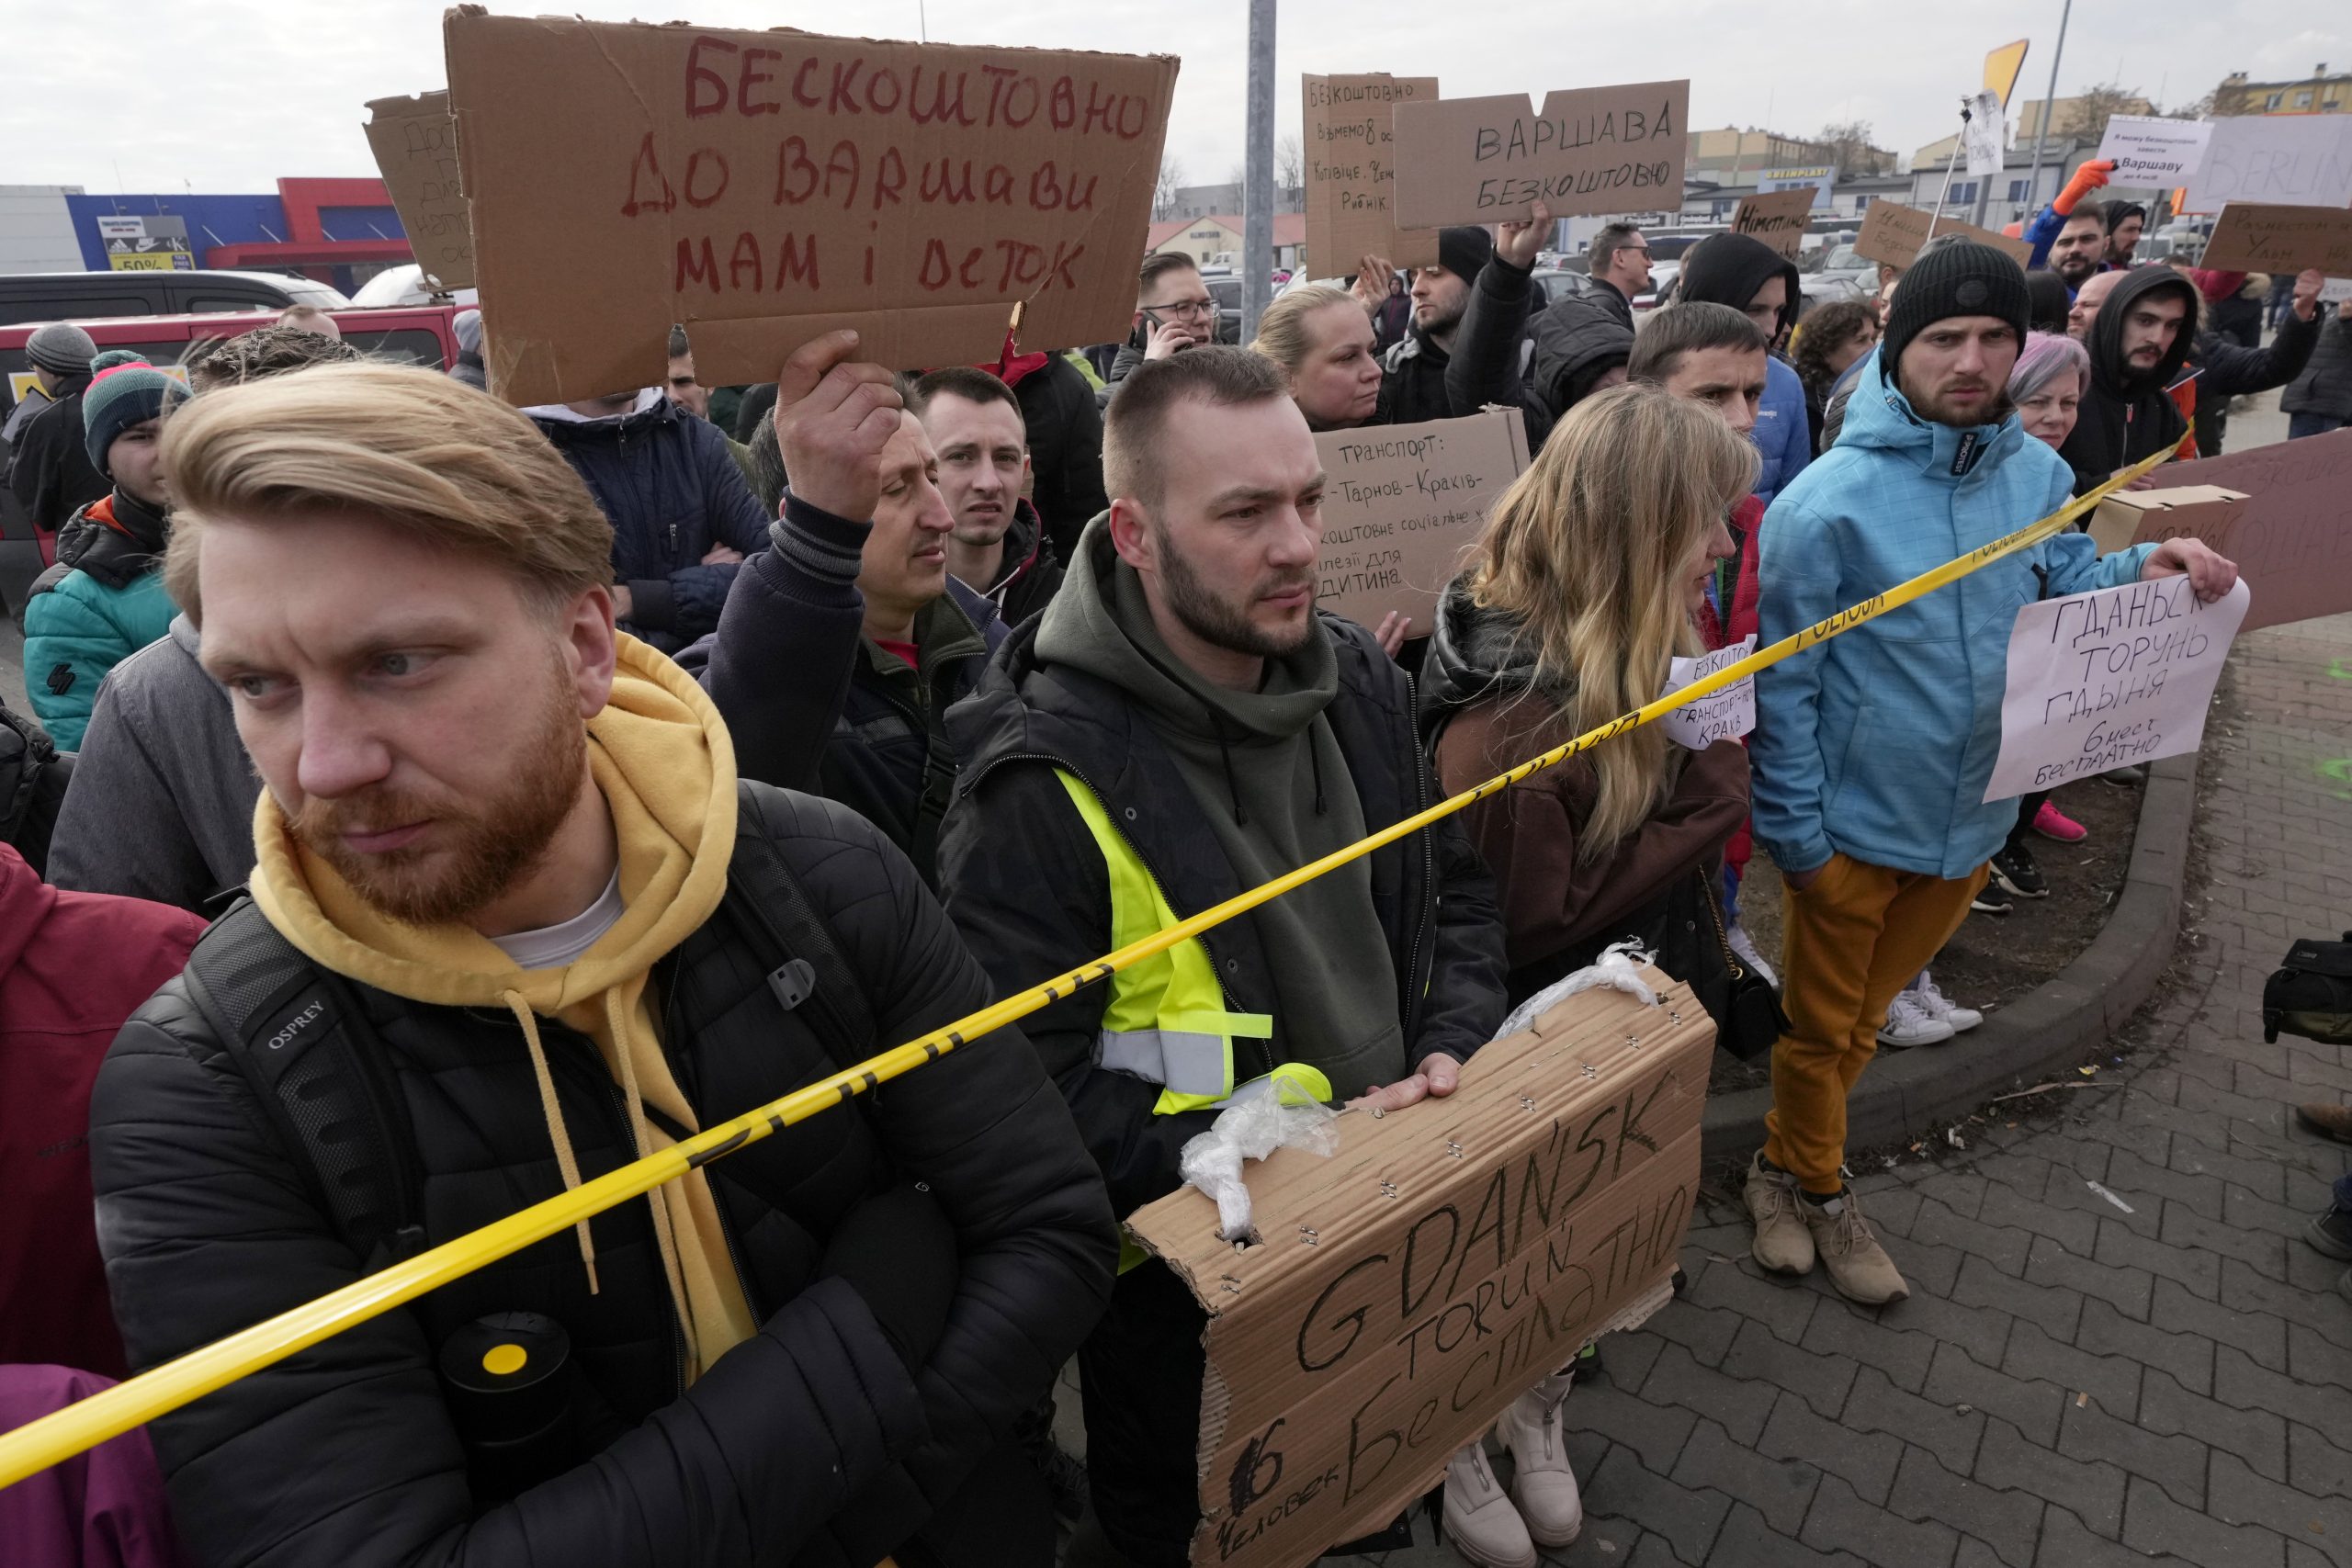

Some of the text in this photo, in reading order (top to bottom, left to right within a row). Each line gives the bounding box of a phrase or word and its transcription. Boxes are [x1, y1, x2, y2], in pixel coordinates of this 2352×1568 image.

[1366, 118, 1375, 145] 8
[1475, 100, 1671, 163] ВАРШАВА
[621, 130, 731, 217] ДО
[1476, 161, 1671, 209] БЕЗКОШТОВНО
[2121, 157, 2184, 174] Варшаву
[675, 231, 821, 294] МАМ
[2079, 625, 2209, 682] ТОРУНЬ
[2044, 669, 2168, 725] ГДЫНЯ
[267, 1000, 324, 1050] OSPREY
